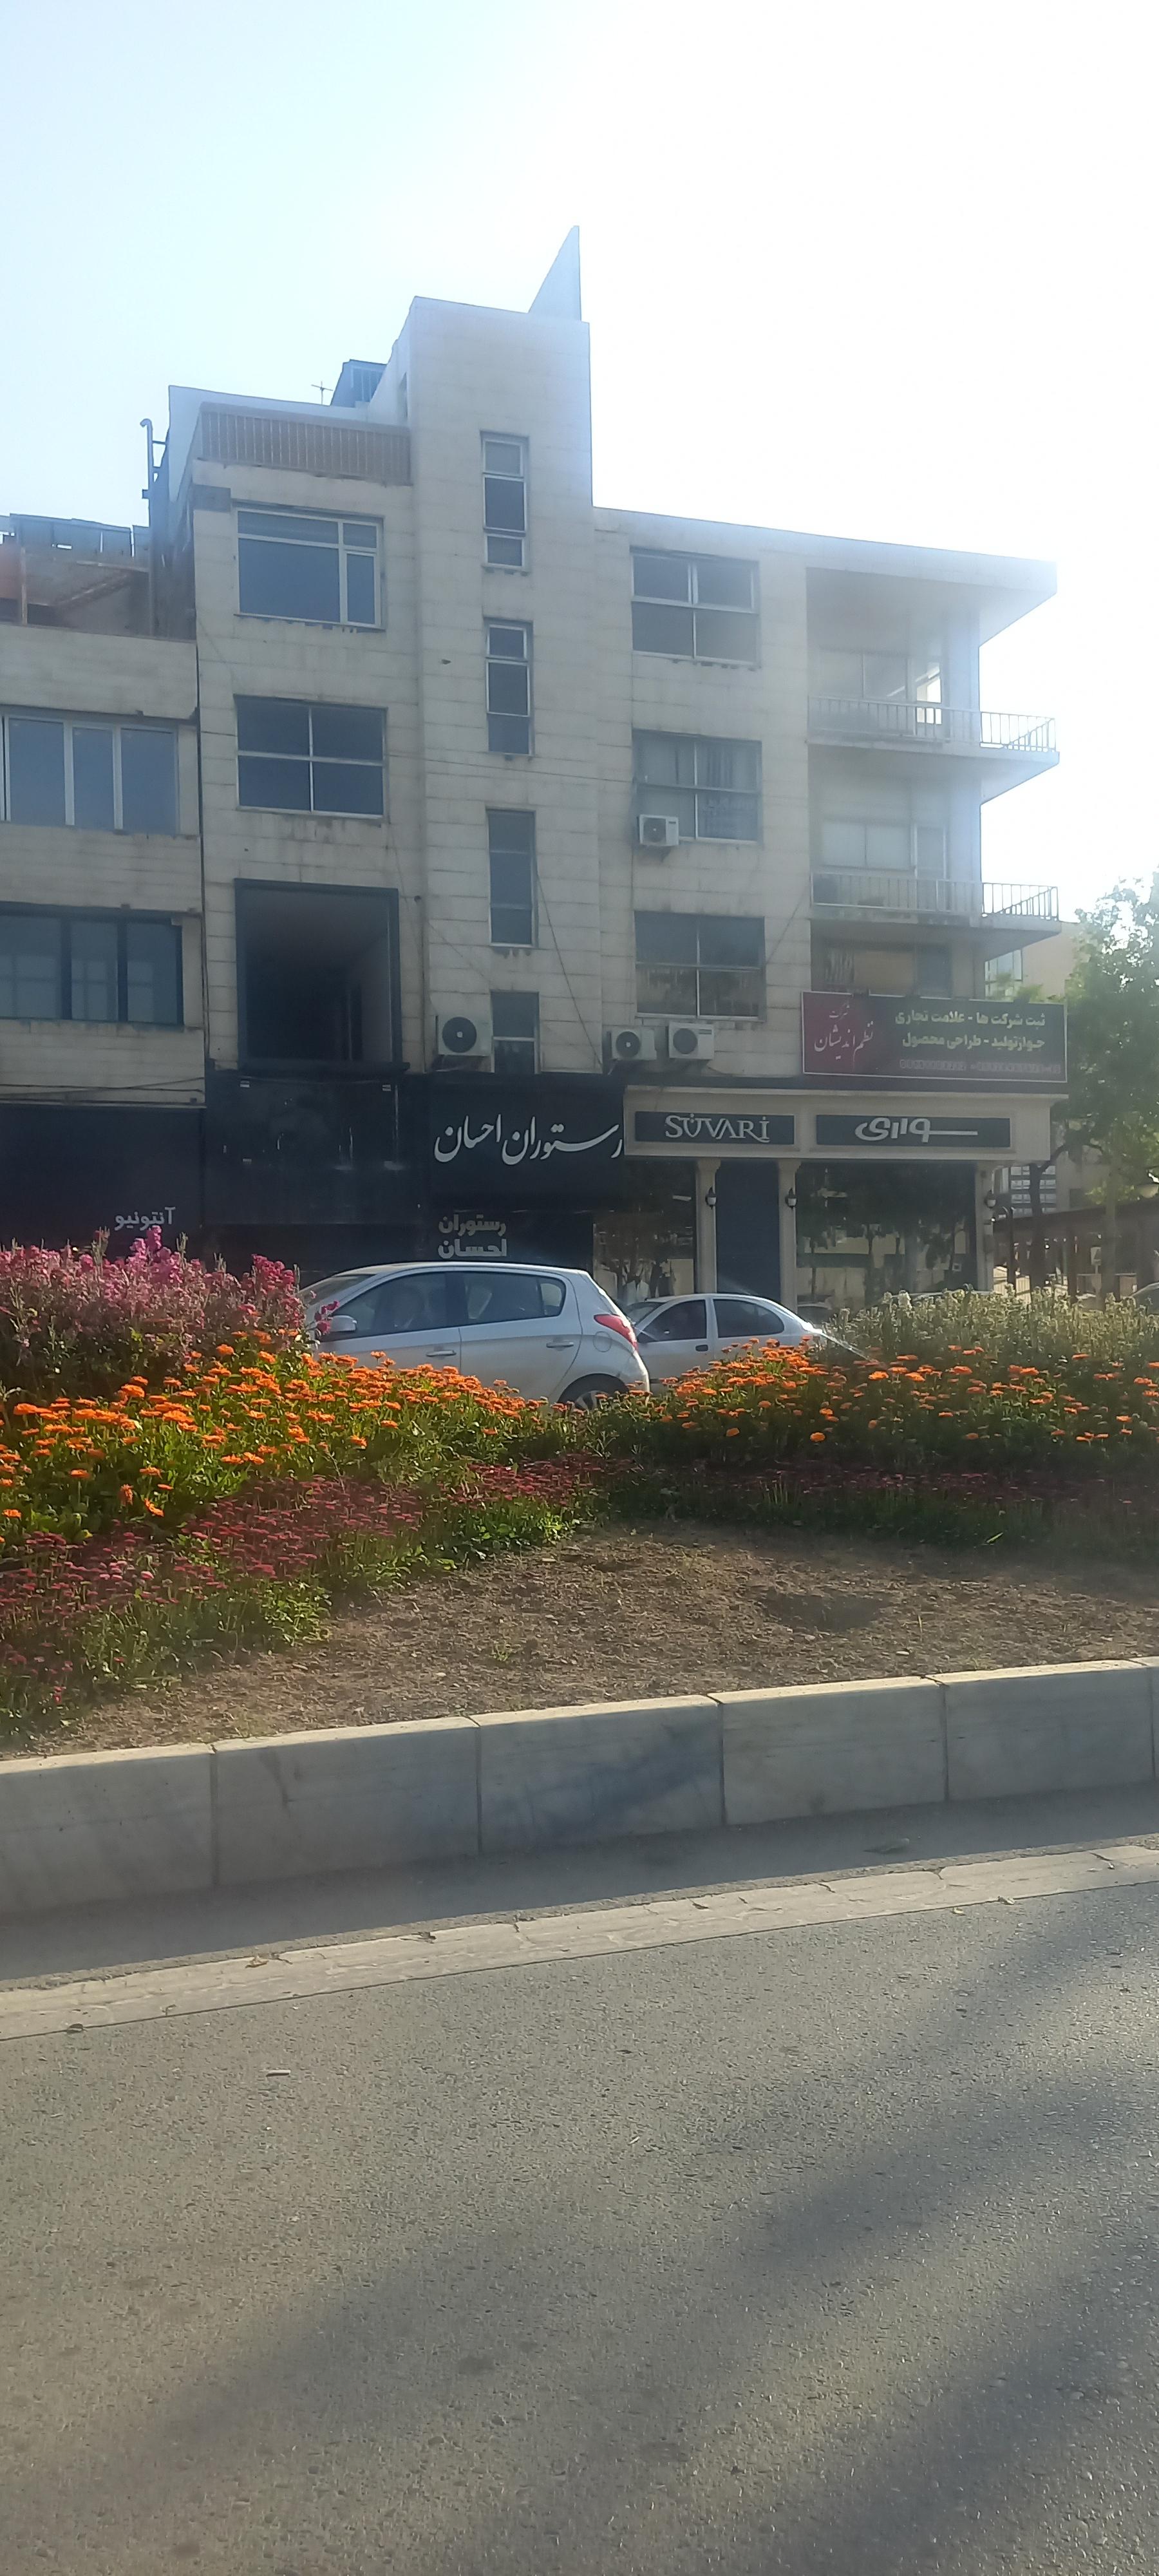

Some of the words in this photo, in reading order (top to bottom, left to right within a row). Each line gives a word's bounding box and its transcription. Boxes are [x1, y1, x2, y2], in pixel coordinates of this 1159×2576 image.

[894, 1009, 928, 1025] تجاری
[930, 1010, 965, 1023] علامت
[975, 1012, 989, 1025] ها
[990, 1013, 1023, 1029] شرکت
[1026, 1012, 1046, 1030] ثبت
[902, 1032, 945, 1048] محصول
[946, 1034, 982, 1050] طراحی
[434, 1113, 502, 1163] احسان
[502, 1116, 623, 1165] رستوران
[114, 1206, 176, 1231] آنتونیو
[438, 1214, 507, 1237] رستوران
[437, 1238, 508, 1260] احسان
